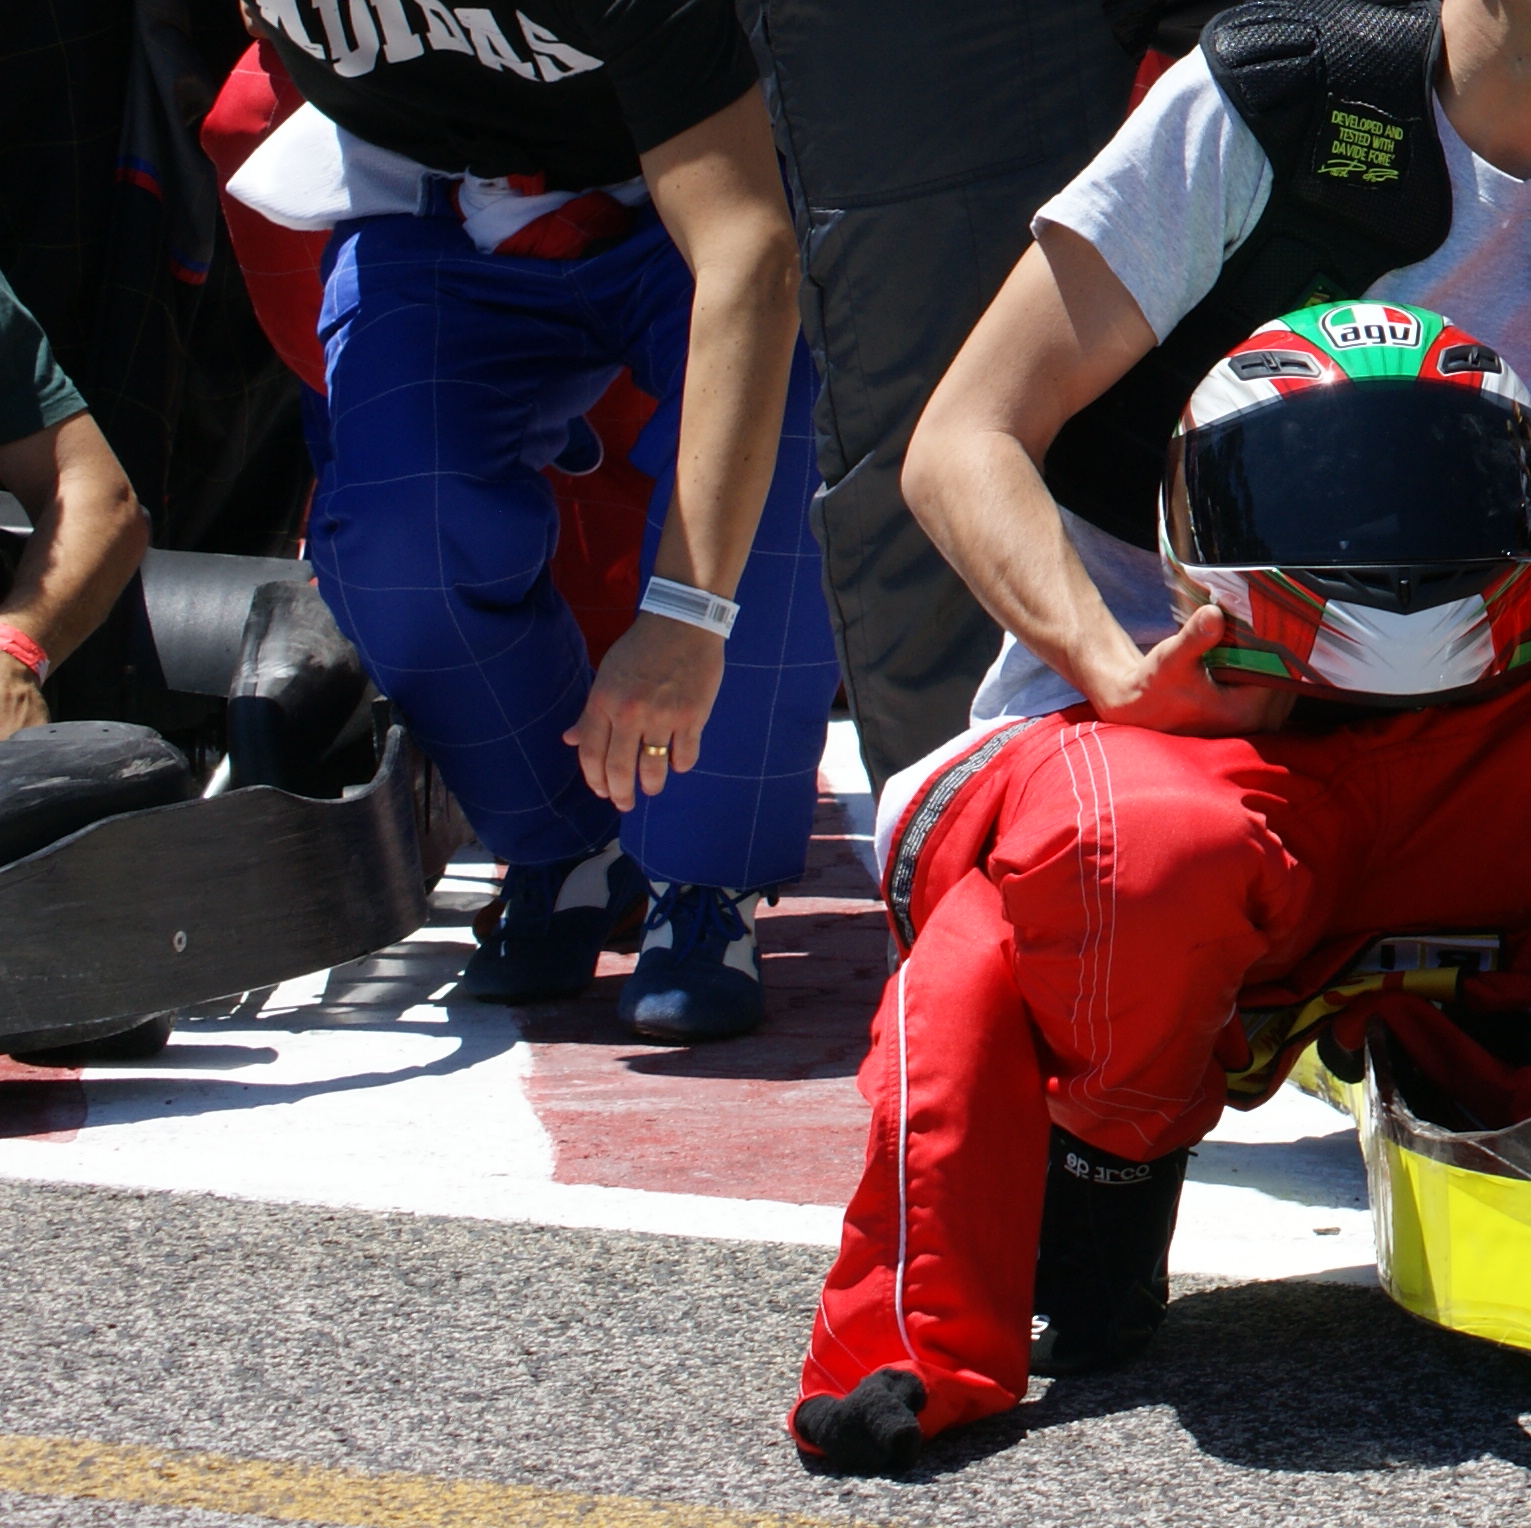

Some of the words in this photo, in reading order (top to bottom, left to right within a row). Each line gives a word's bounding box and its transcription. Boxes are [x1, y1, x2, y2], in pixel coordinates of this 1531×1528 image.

[1331, 110, 1383, 135] DEVELOPED
[1385, 124, 1404, 141] AND
[1331, 140, 1367, 161] DAVIDE
[1339, 127, 1371, 146] TESTED
[1371, 136, 1395, 152] WITH
[1340, 323, 1411, 346] agv
